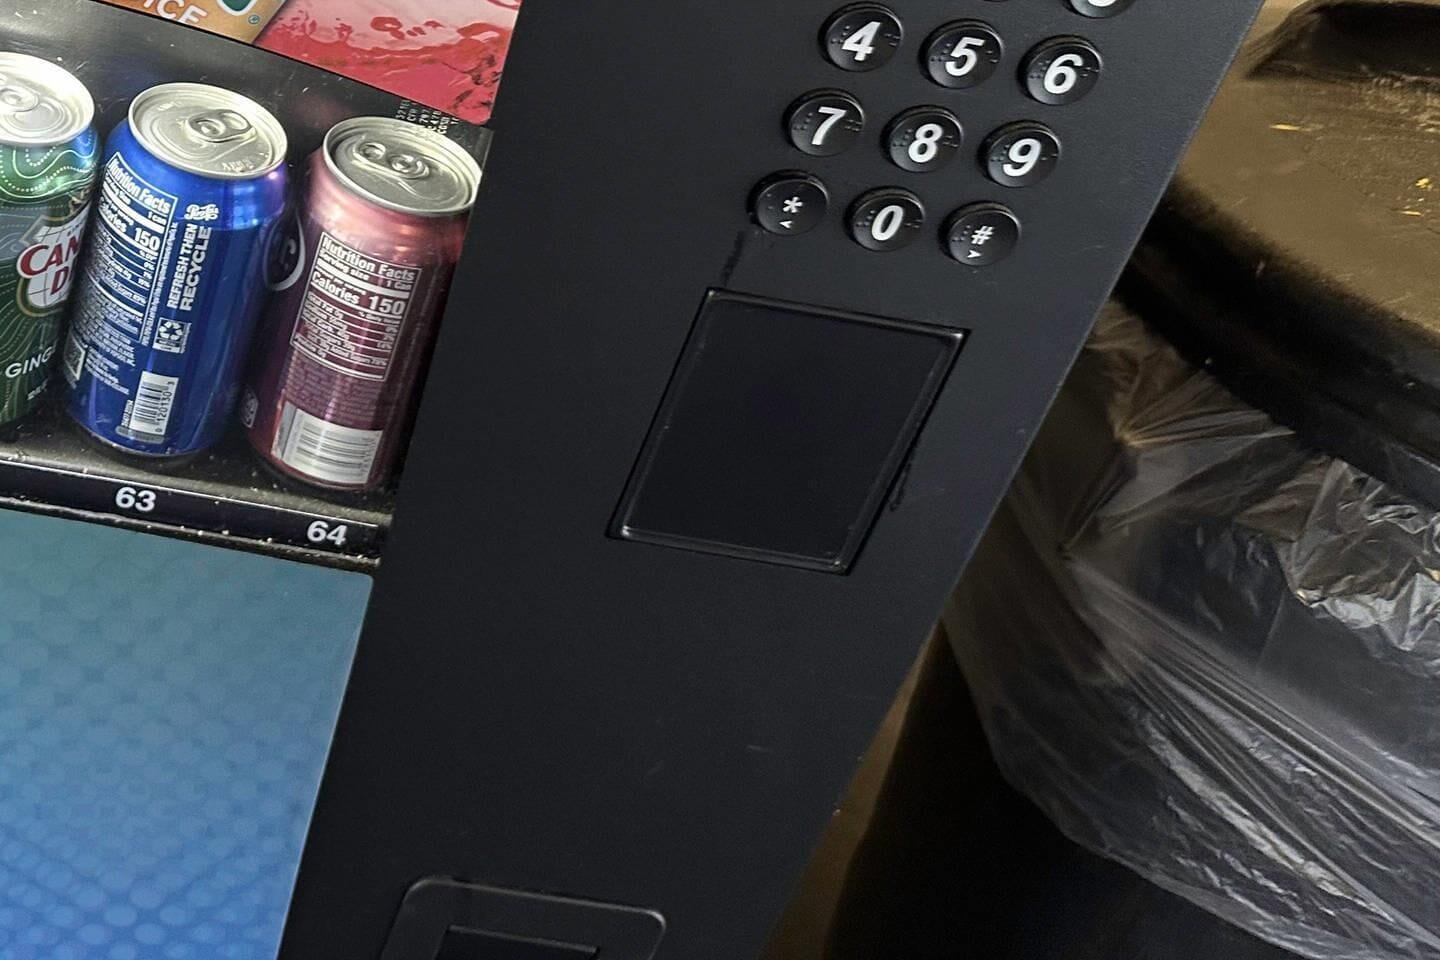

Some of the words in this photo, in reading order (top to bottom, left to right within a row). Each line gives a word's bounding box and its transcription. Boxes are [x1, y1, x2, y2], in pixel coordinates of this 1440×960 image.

[841, 20, 881, 61] 4
[945, 36, 985, 77] 5
[1044, 53, 1084, 95] 6
[812, 106, 847, 146] 7
[907, 123, 943, 163] 8
[1002, 137, 1042, 177] 9
[109, 158, 140, 197] Nutrition
[140, 189, 171, 214] Facts
[135, 227, 160, 251] 150
[871, 204, 904, 241] 0
[167, 257, 190, 309] REFRESH
[180, 224, 199, 258] THEN
[180, 226, 211, 311] RECYCLE
[319, 250, 349, 274] Serving
[322, 237, 375, 272] Nutrition
[378, 264, 415, 281] Facts
[312, 271, 360, 305] Calories
[369, 295, 405, 315] 150
[5, 346, 55, 378] GING
[115, 486, 156, 512] 63
[306, 521, 348, 546] 64
